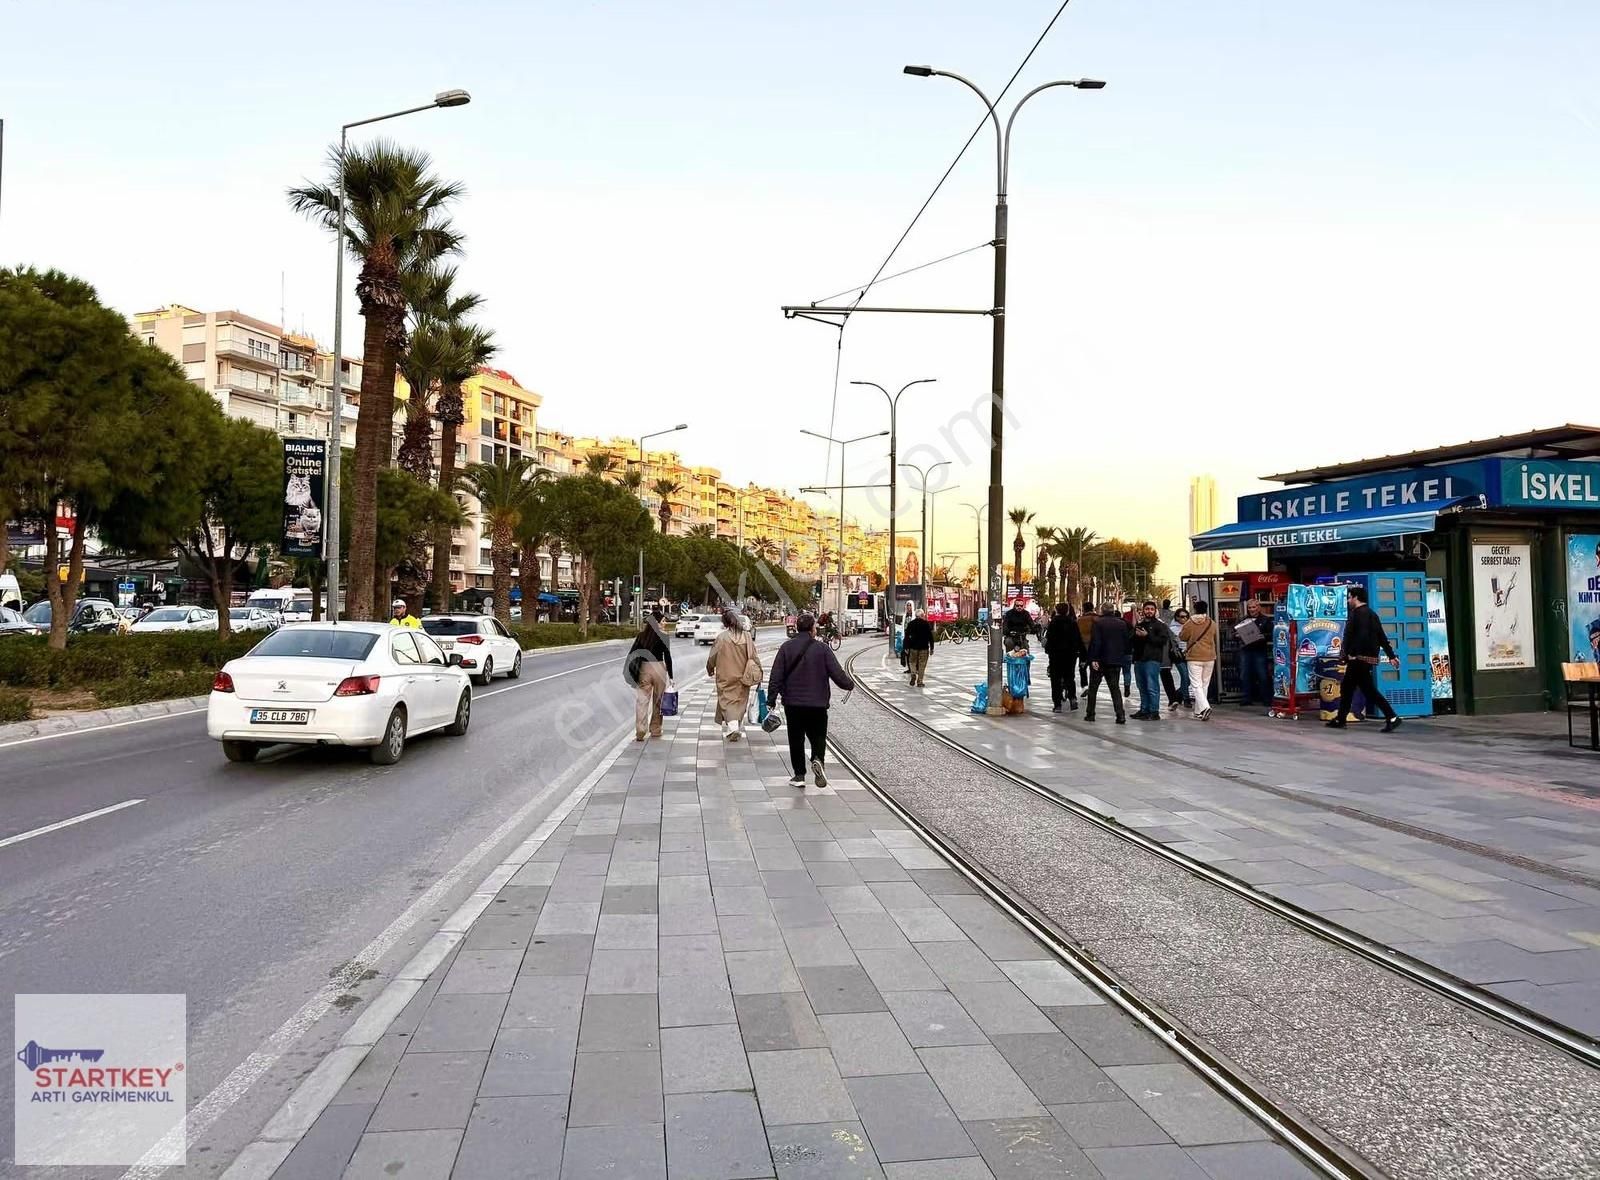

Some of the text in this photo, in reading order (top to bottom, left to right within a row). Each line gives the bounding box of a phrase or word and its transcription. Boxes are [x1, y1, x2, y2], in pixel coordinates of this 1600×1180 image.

[285, 444, 324, 453] BIALIN'S
[286, 456, 322, 467] Online
[1261, 491, 1350, 521] İSKELE
[1257, 528, 1342, 546] İSKELE TEKEL
[1481, 556, 1502, 565] SERBEST
[257, 711, 306, 721] 35 CLB 786
